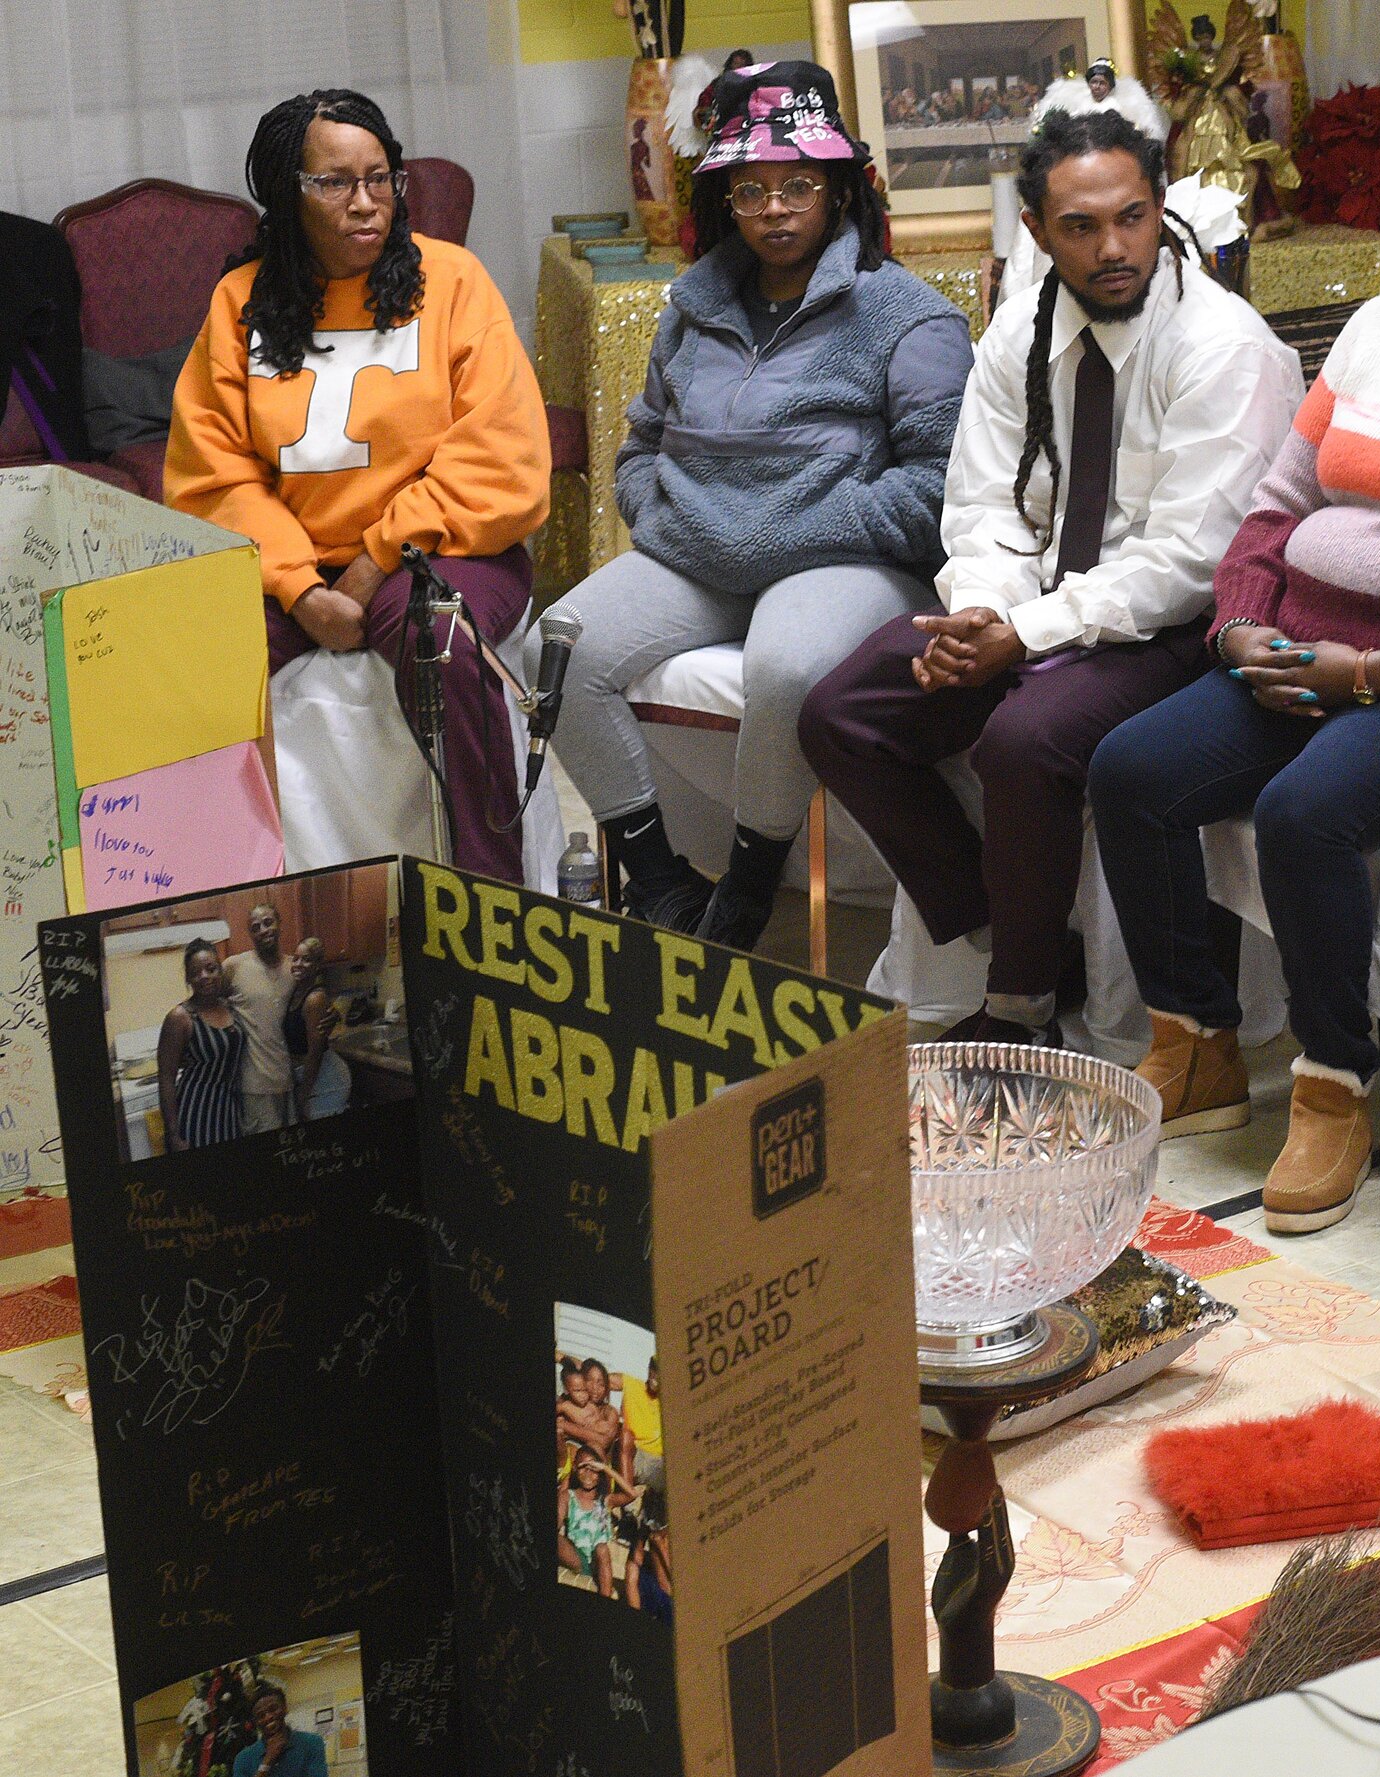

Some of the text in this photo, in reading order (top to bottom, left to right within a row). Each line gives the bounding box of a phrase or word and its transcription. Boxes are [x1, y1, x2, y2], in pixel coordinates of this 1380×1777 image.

[248, 318, 420, 473] T
[417, 863, 621, 1015] REST
[765, 1131, 817, 1196] GEAR
[686, 1256, 819, 1355] PROJECT
[689, 1309, 793, 1392] BOARD
